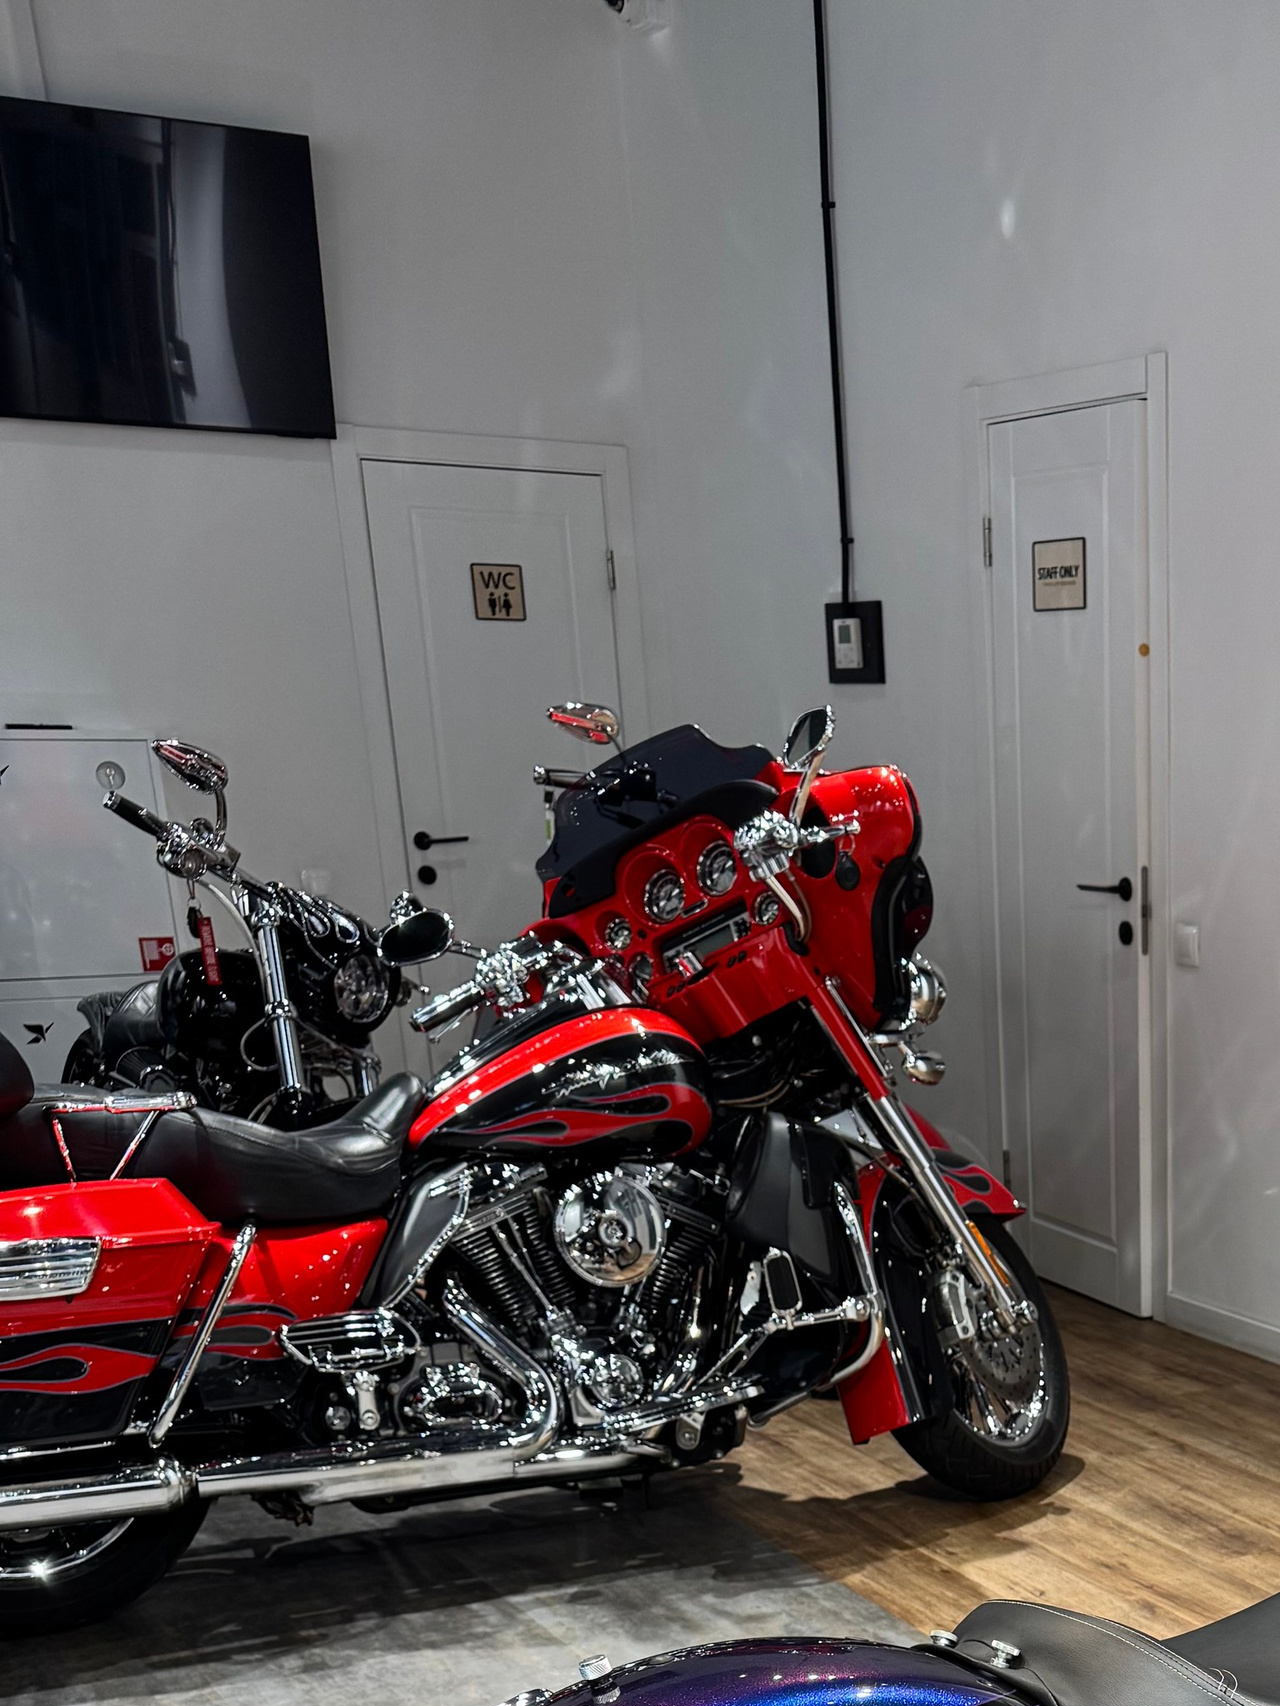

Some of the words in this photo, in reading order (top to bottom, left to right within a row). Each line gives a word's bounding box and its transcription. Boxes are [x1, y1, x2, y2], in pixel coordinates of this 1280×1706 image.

[479, 571, 516, 590] WC
[1037, 566, 1058, 580] STAFF
[1059, 565, 1080, 579] ONLY
